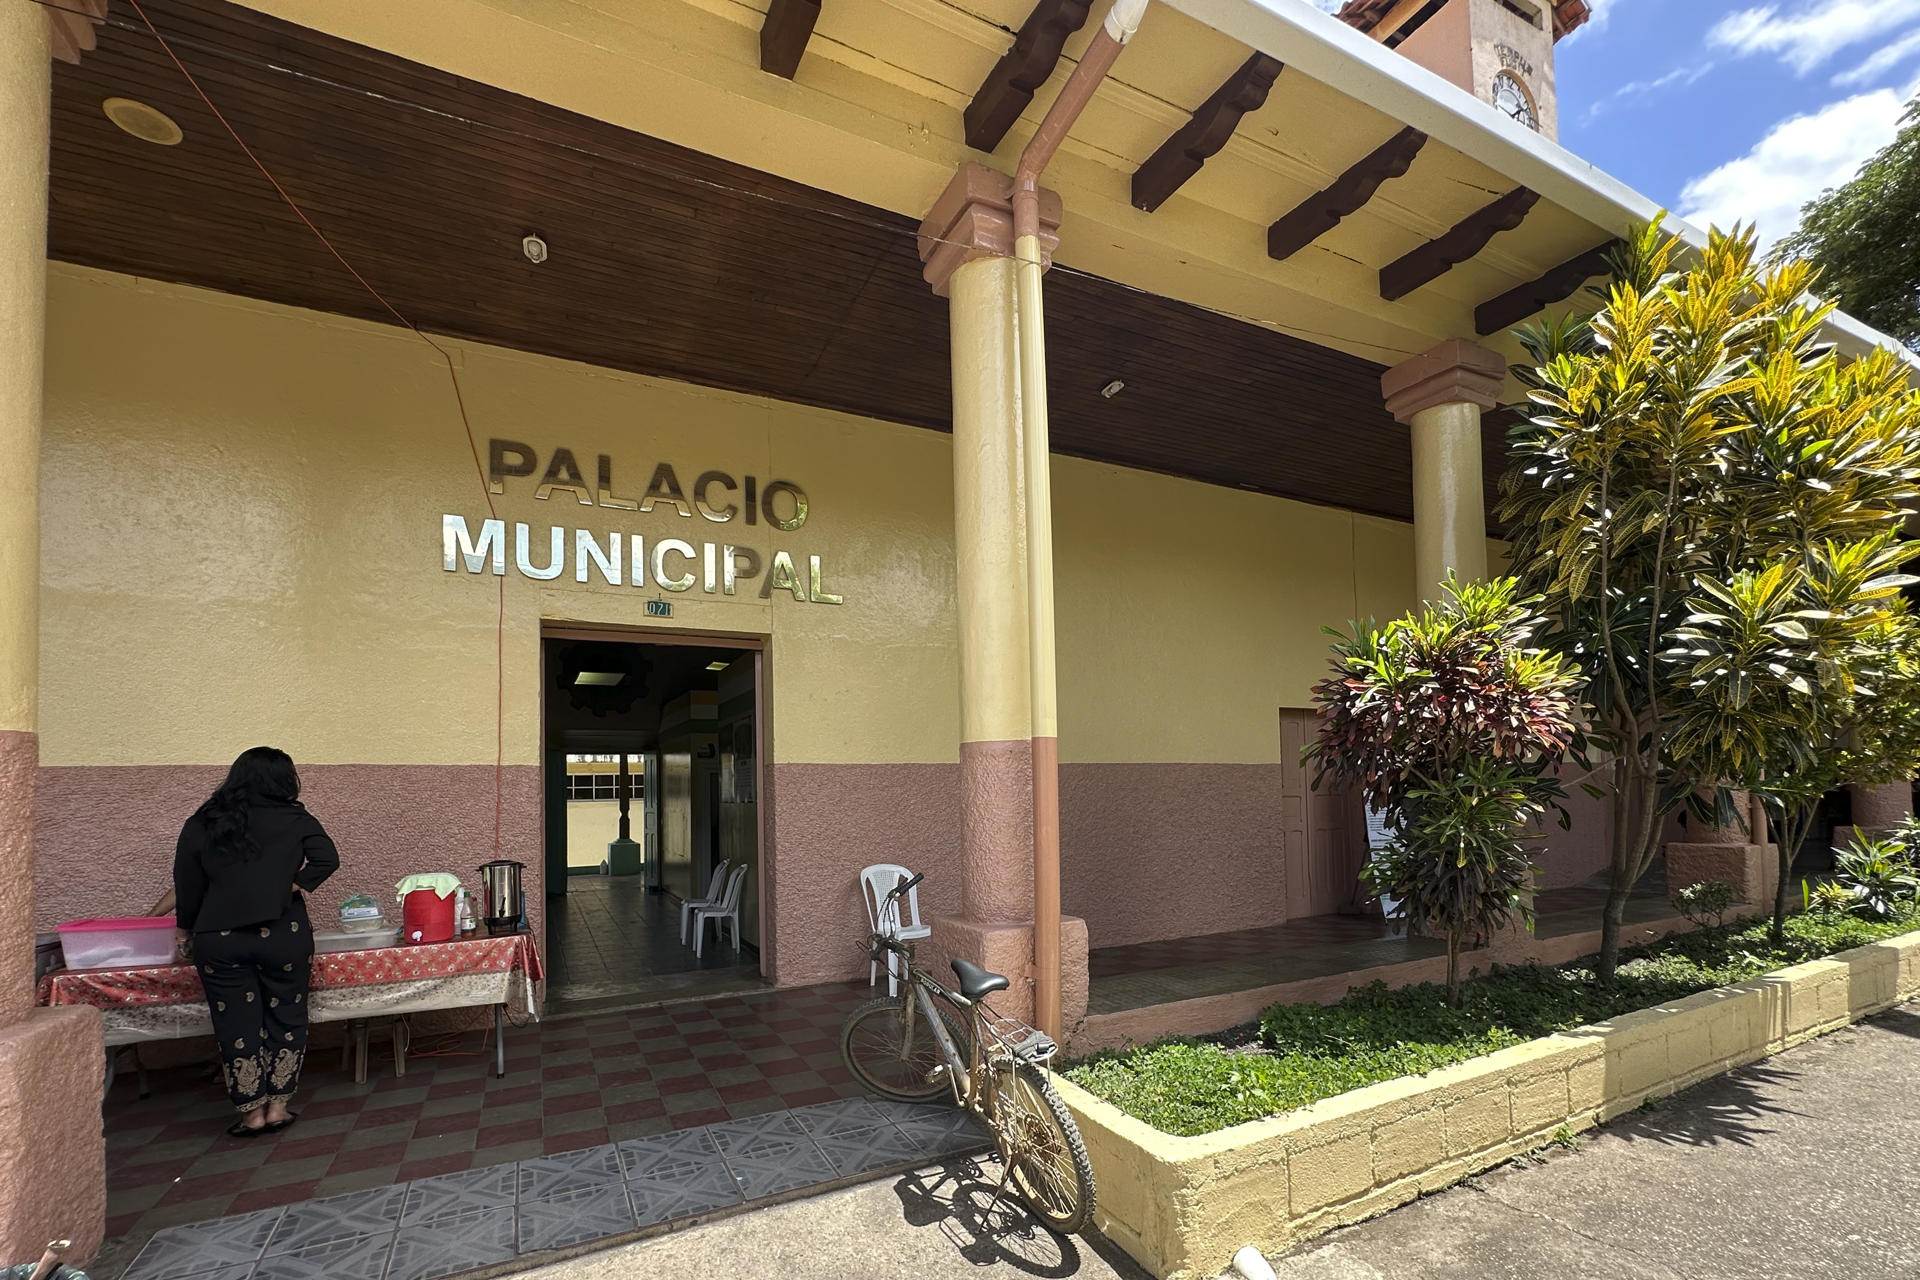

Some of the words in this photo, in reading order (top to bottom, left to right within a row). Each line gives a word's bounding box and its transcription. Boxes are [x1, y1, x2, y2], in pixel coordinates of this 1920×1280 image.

[488, 438, 810, 532] PALACIO
[442, 513, 843, 605] MUNICIPAL
[649, 602, 669, 616] 071
